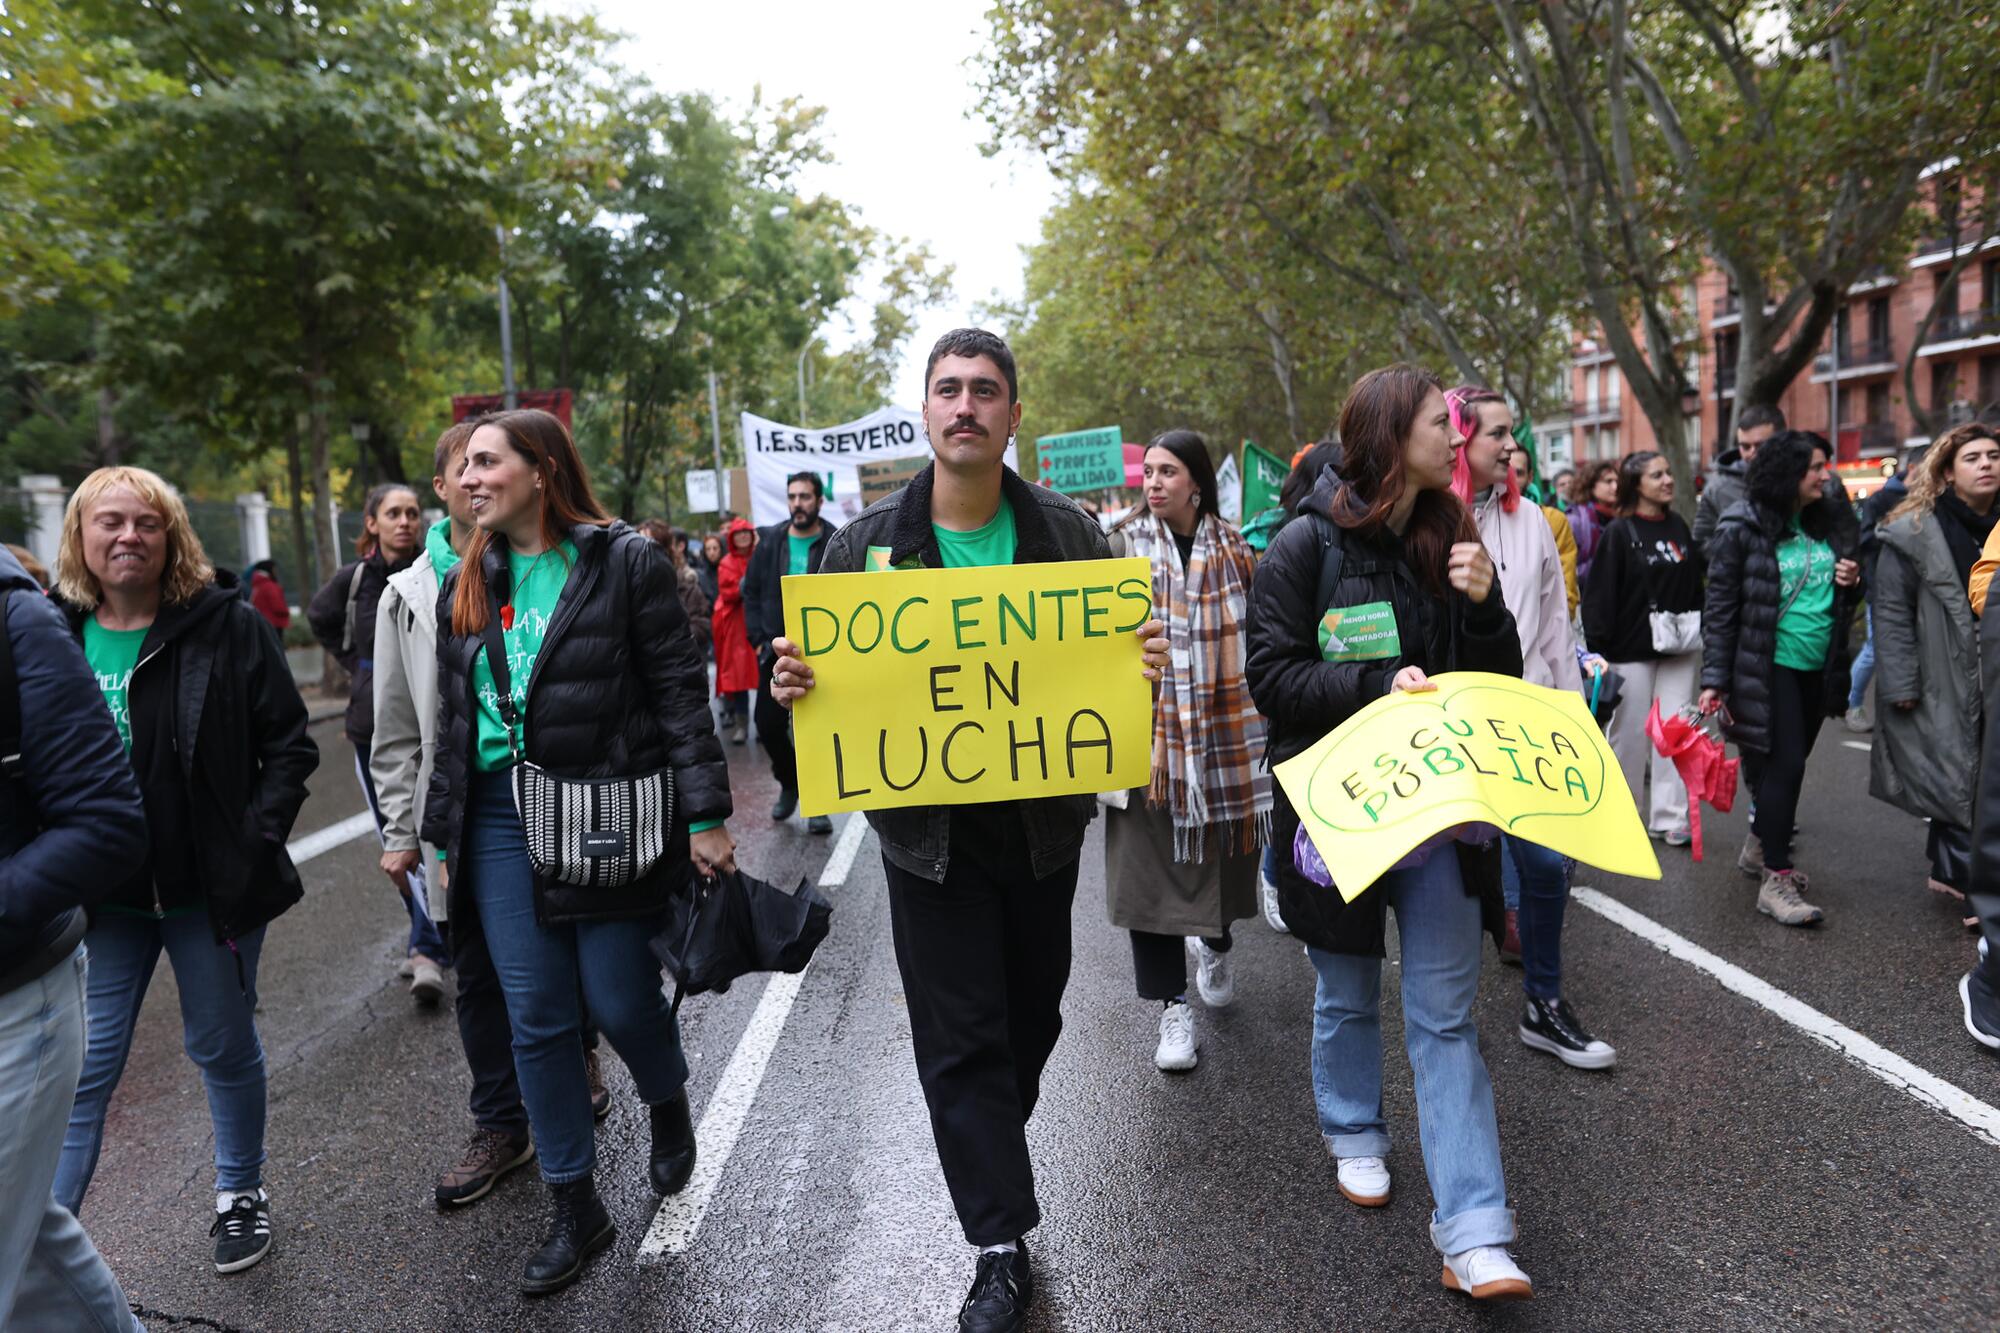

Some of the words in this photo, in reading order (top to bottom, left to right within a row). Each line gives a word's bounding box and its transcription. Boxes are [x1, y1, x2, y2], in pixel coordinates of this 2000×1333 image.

[756, 429, 815, 454] I.E.S.
[821, 420, 915, 453] SEVERO
[1054, 452, 1107, 470] PROFES
[1055, 468, 1117, 488] CALIDAD
[800, 578, 1153, 657] DOCENTES
[1343, 615, 1366, 624] MENOS
[1367, 611, 1389, 620] HORAS
[929, 660, 1020, 713] EN
[832, 708, 1113, 800] LUCHA
[1341, 718, 1580, 801] ESCUELA
[1362, 742, 1590, 823] PÚBLICA
